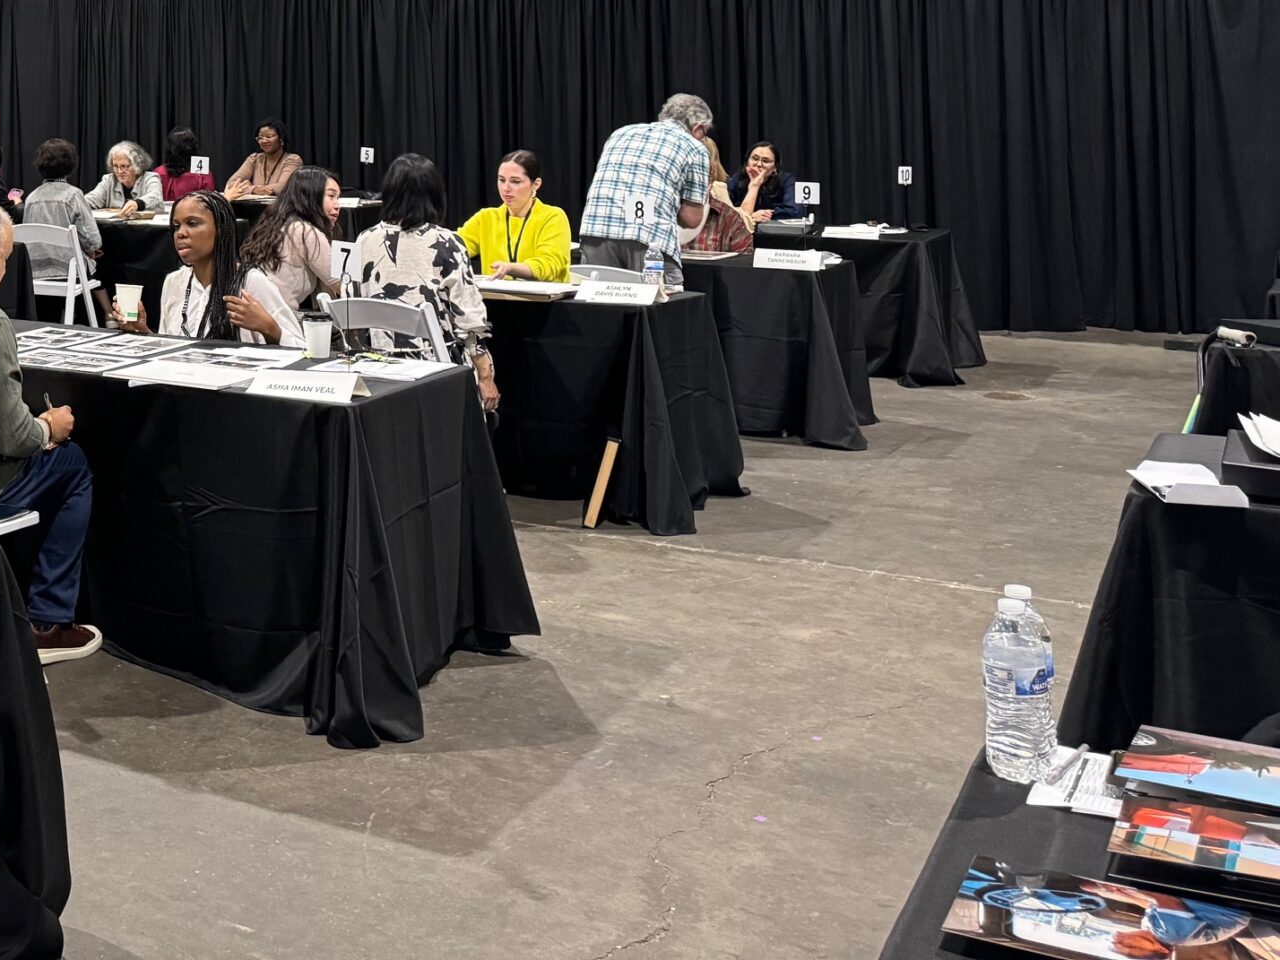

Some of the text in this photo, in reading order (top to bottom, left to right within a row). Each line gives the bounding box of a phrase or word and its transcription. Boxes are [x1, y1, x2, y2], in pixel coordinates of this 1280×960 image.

[364, 149, 370, 160] 5
[196, 159, 203, 170] 4
[901, 169, 910, 181] 10
[802, 185, 812, 200] 9
[634, 200, 645, 218] 8
[340, 247, 352, 273] 7
[266, 383, 336, 395] ASHA IMAN VEAL
